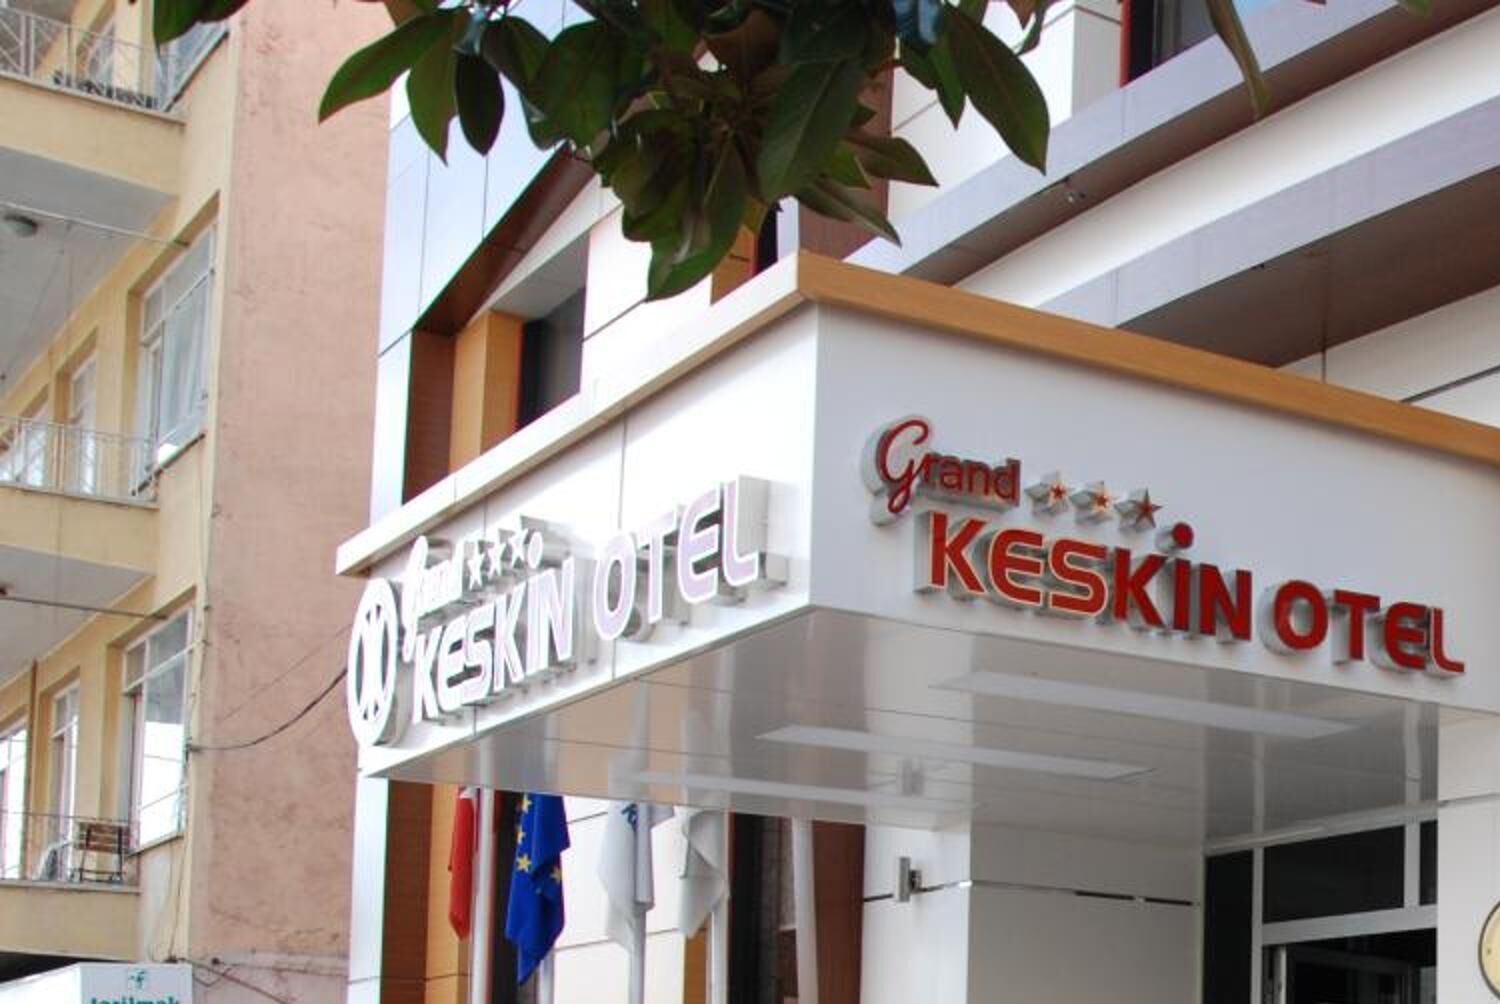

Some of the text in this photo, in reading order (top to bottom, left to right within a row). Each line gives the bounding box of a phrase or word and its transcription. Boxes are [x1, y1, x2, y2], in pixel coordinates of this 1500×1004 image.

[874, 418, 1022, 513] Grand
[593, 474, 760, 641] OTEL
[1273, 579, 1466, 674] OTEL
